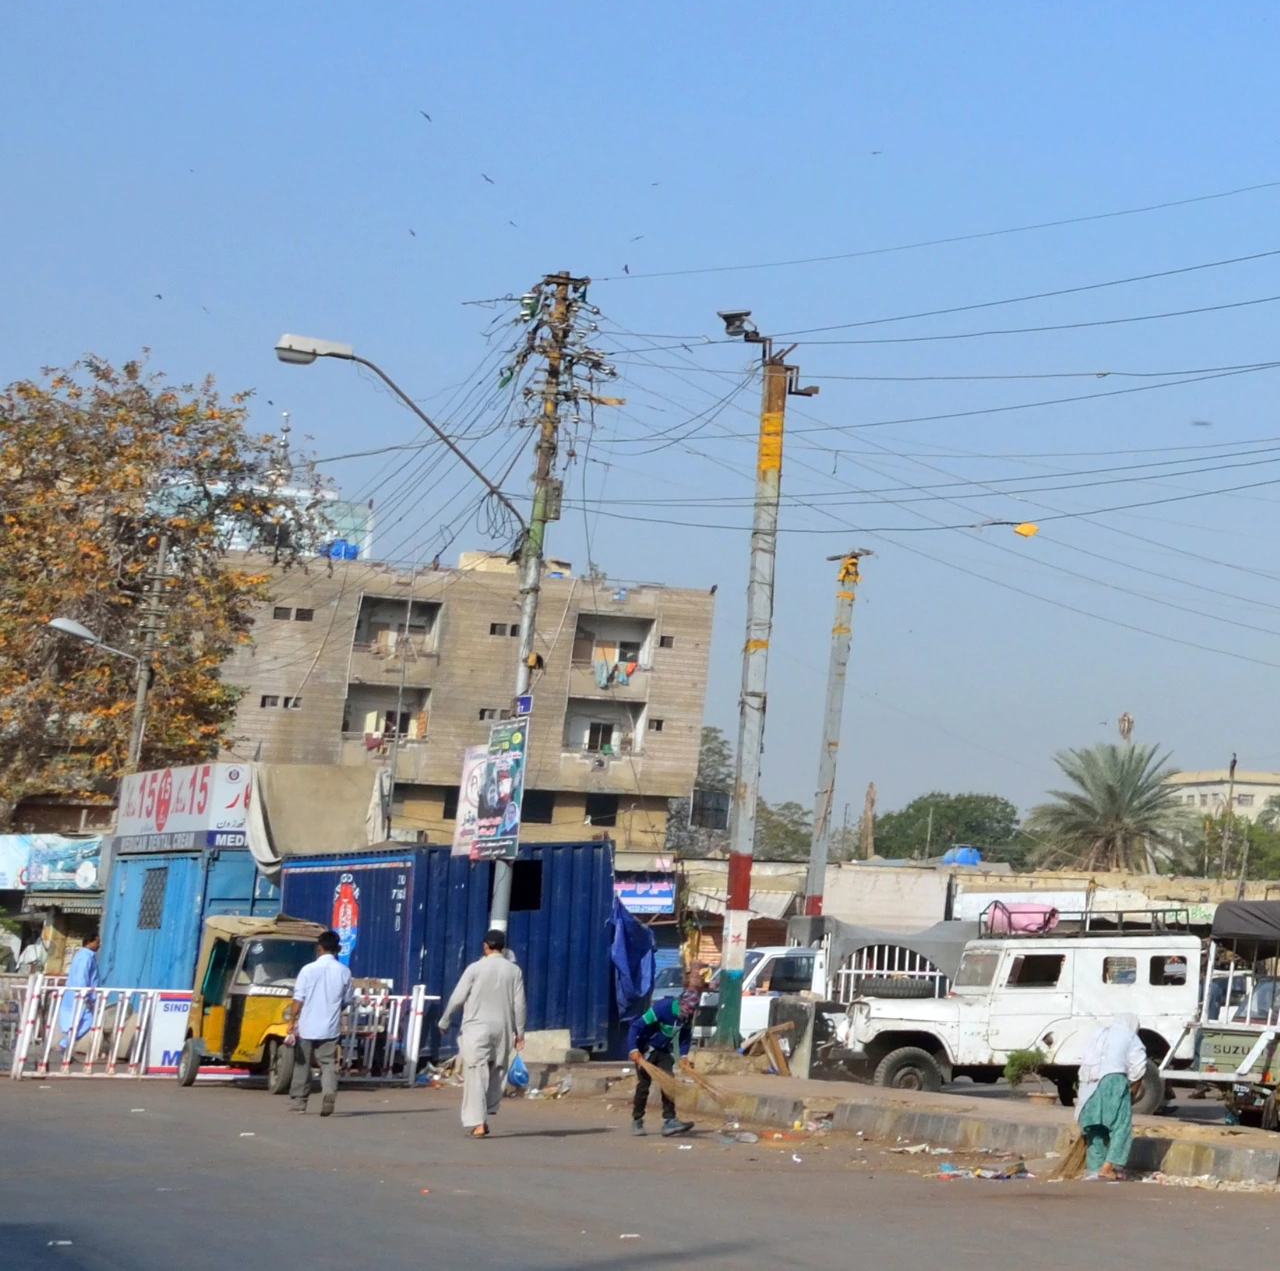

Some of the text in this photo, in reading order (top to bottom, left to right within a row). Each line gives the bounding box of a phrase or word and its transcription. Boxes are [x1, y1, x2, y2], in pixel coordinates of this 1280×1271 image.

[139, 772, 158, 818] 15
[189, 765, 211, 815] 15
[249, 985, 289, 995] MASTER
